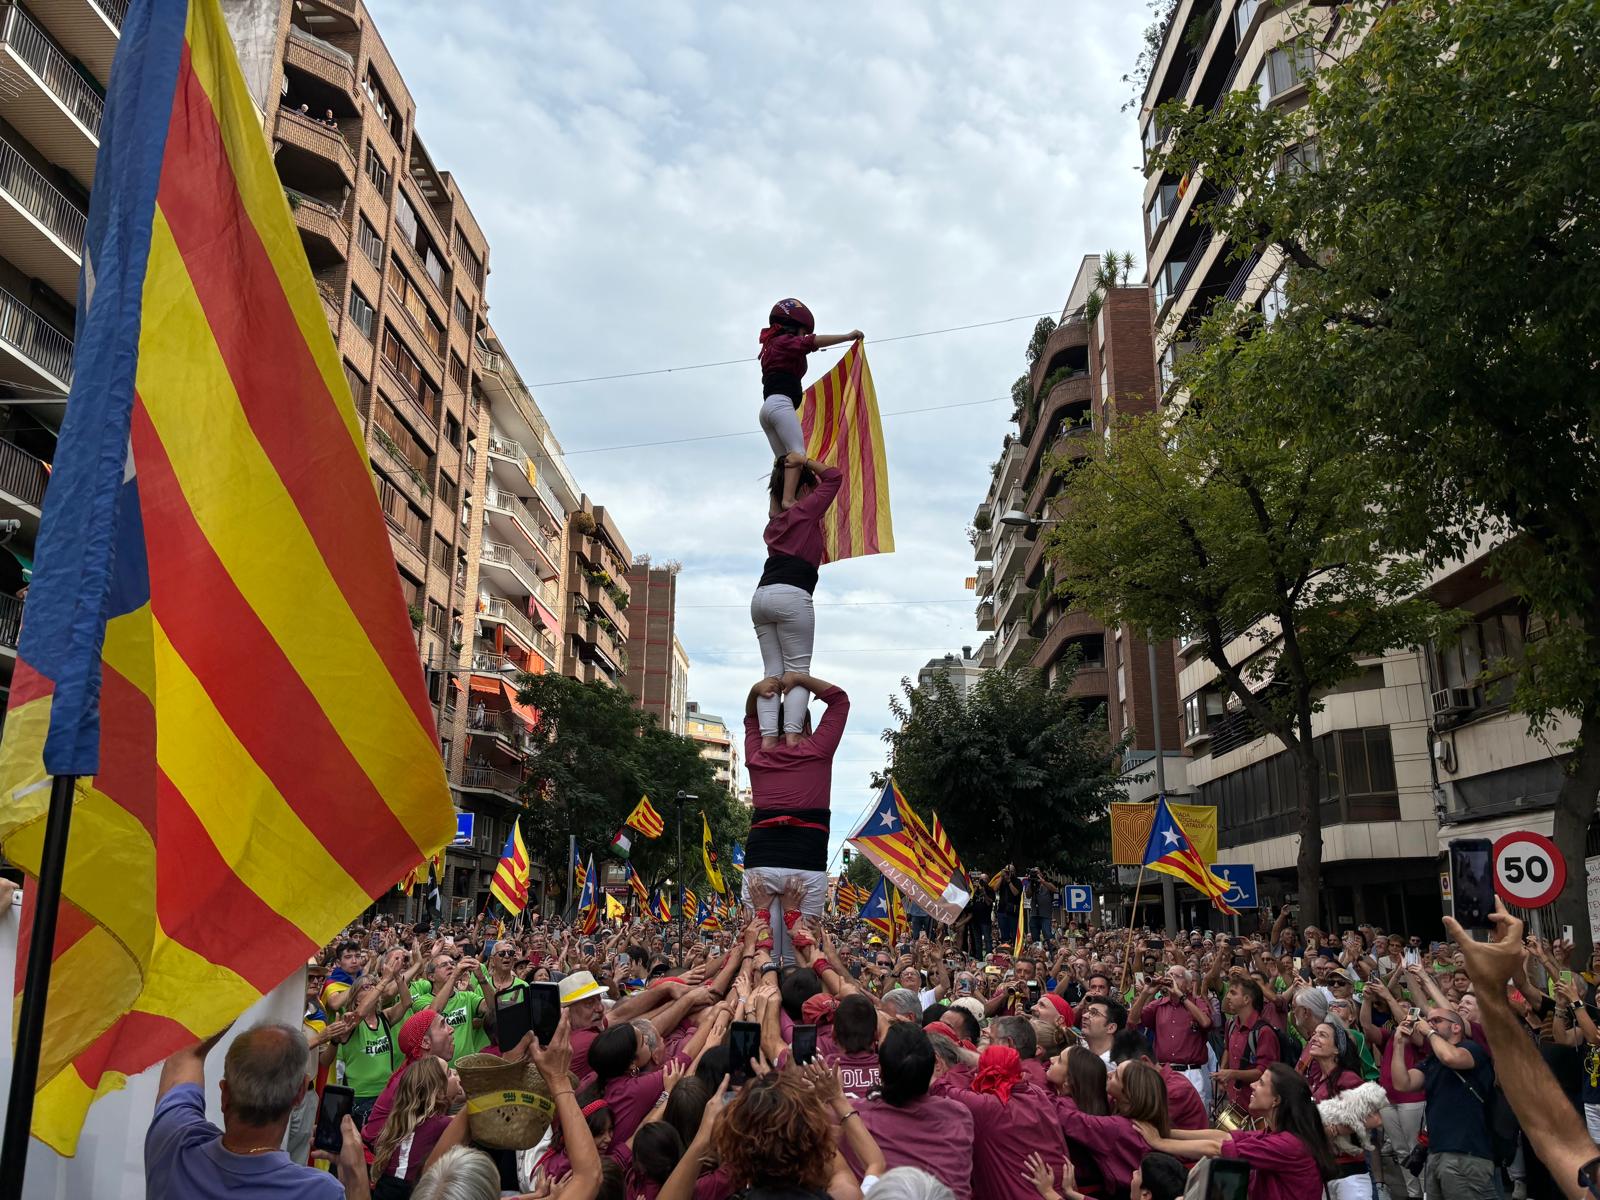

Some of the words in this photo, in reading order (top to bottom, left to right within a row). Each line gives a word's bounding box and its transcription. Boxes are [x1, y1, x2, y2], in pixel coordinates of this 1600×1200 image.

[1504, 856, 1548, 883] 50
[878, 860, 953, 923] PALESTINE
[1070, 888, 1087, 909] P
[374, 1044, 390, 1055] CAM
